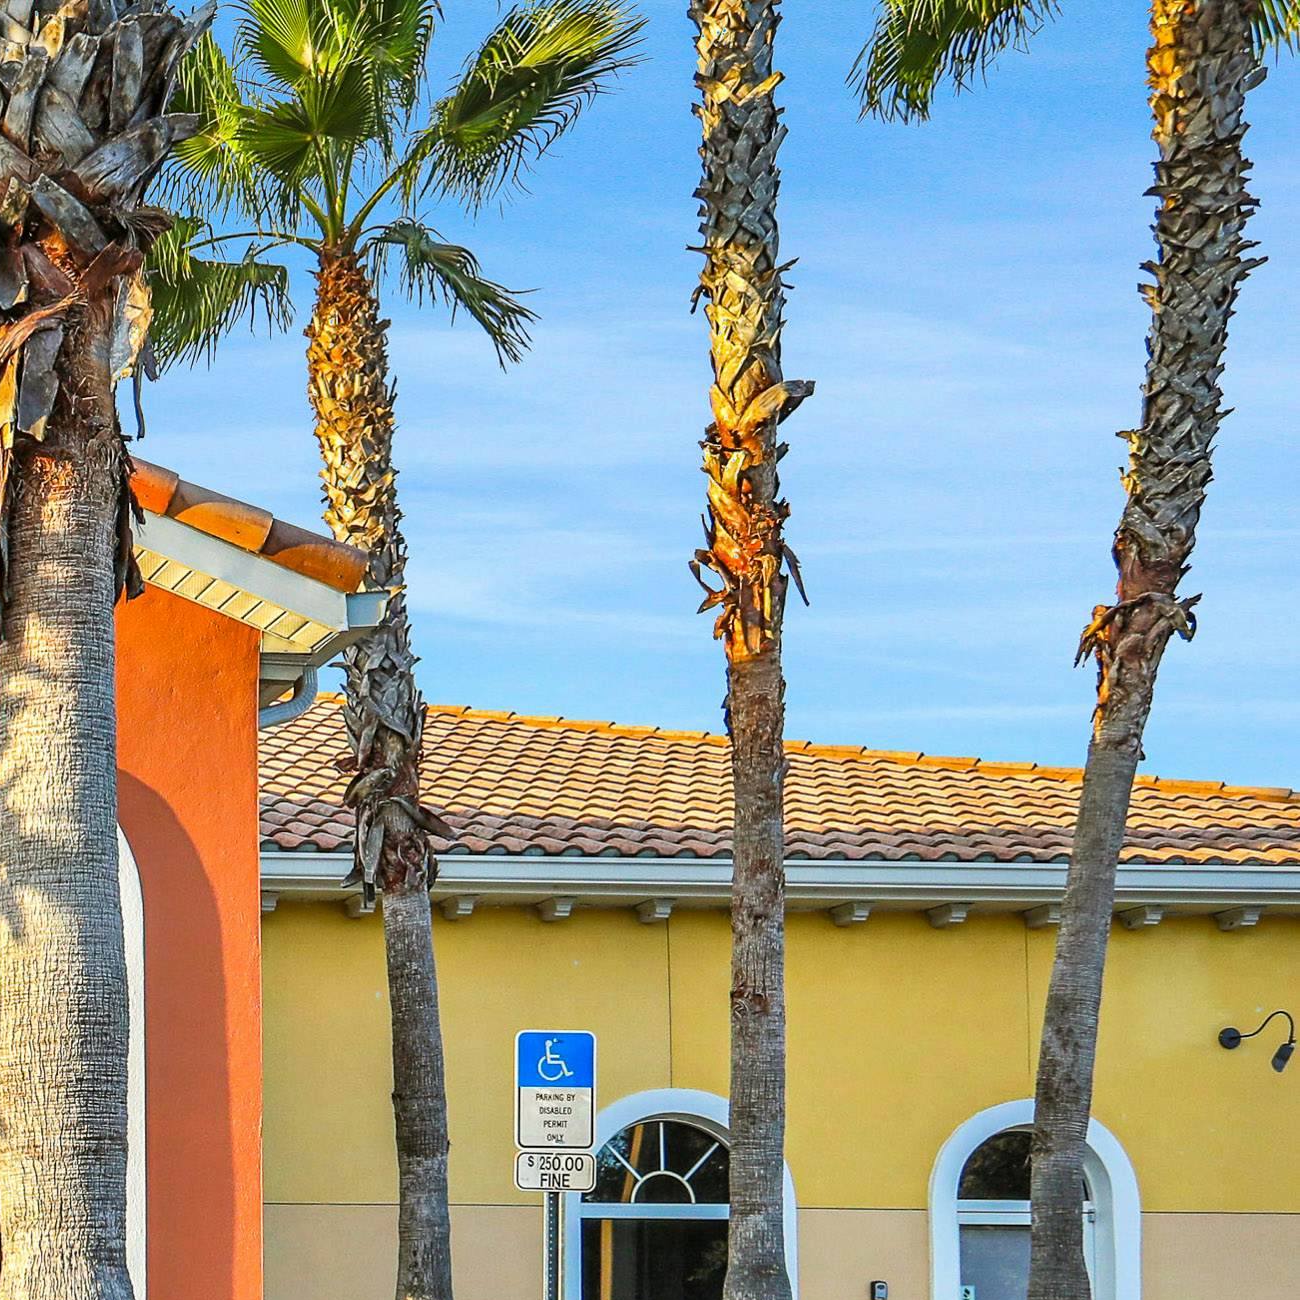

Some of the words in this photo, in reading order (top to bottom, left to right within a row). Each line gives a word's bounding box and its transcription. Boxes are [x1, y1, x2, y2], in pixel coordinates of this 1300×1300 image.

[536, 1093, 564, 1101] PARKING
[567, 1093, 576, 1101] BY
[539, 1107, 572, 1115] DISABLED
[546, 1134, 564, 1142] ONLY
[539, 1156, 584, 1171] 250.00
[540, 1174, 570, 1187] FINE
